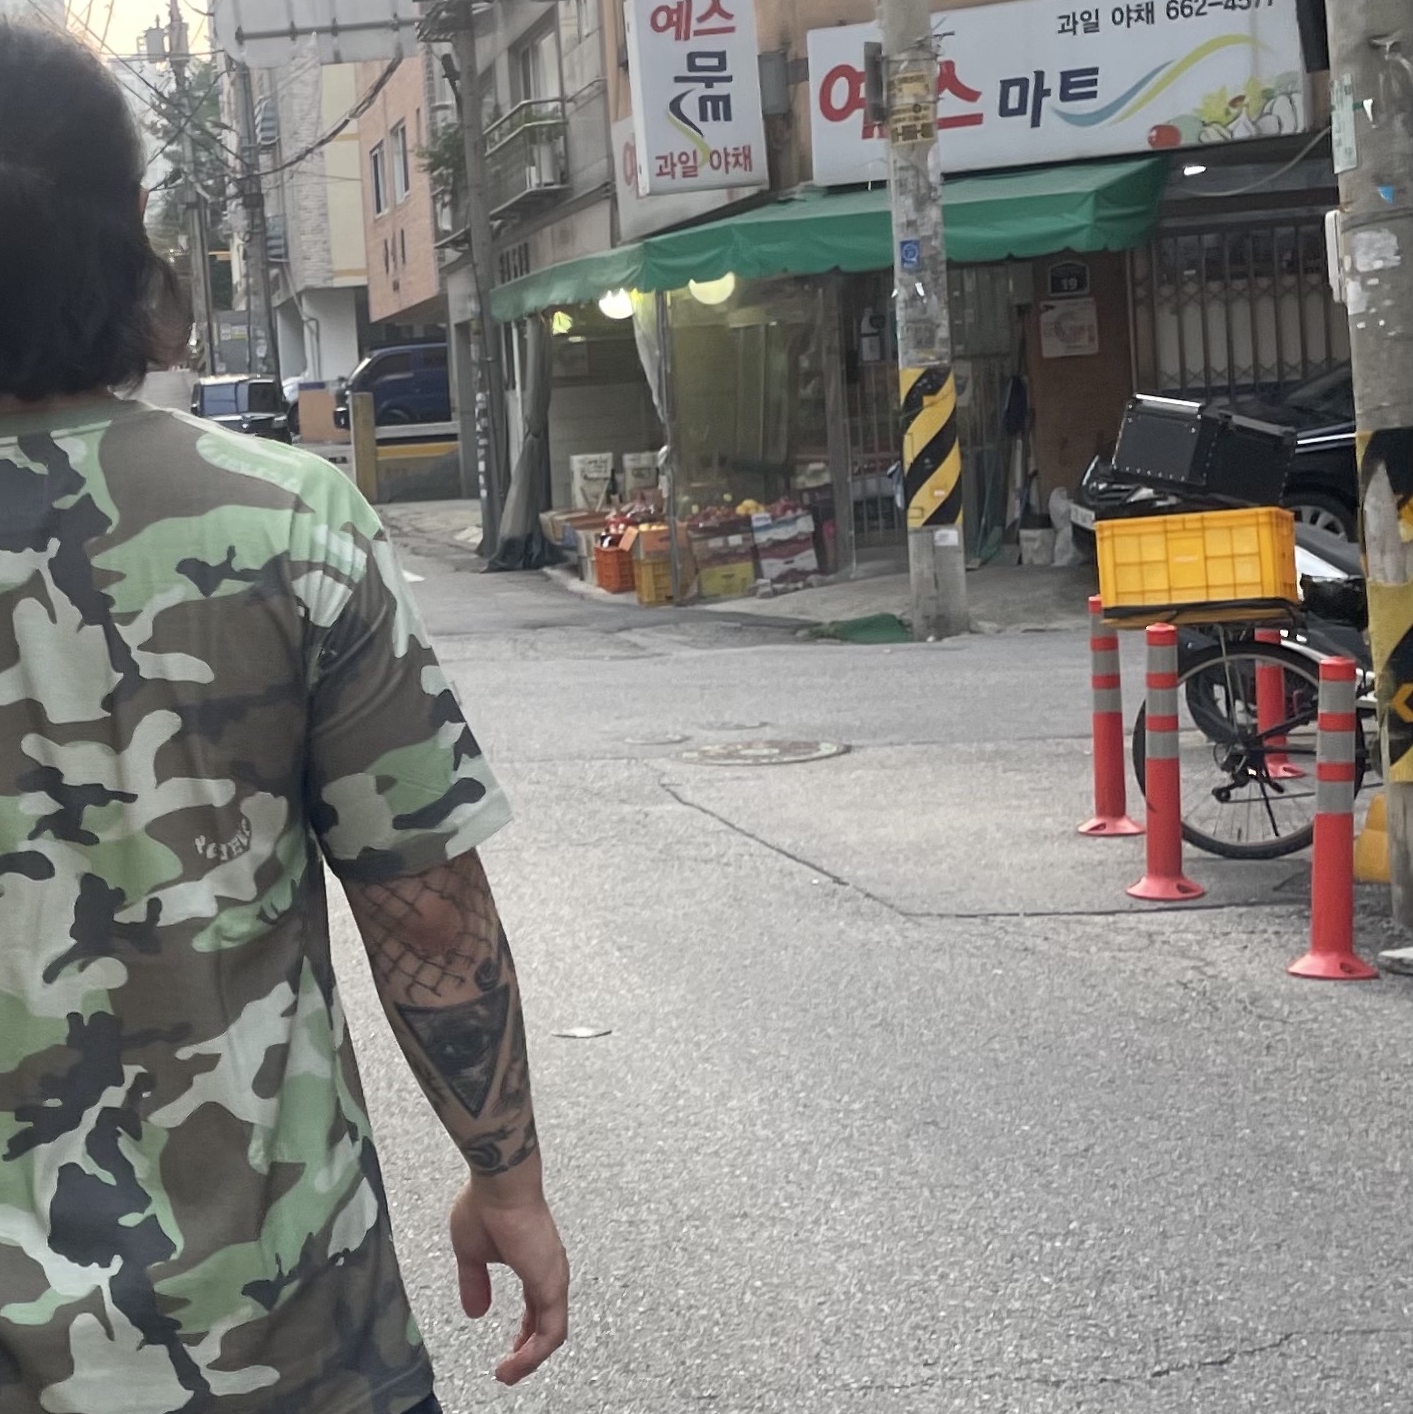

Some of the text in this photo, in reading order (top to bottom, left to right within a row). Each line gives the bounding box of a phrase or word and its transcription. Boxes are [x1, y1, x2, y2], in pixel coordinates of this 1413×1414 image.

[650, 0, 736, 41] 예스
[1057, 8, 1100, 36] 과일
[1112, 1, 1156, 28] 야채
[998, 67, 1099, 128] 마트
[655, 151, 699, 180] 과일
[709, 145, 753, 174] 야채
